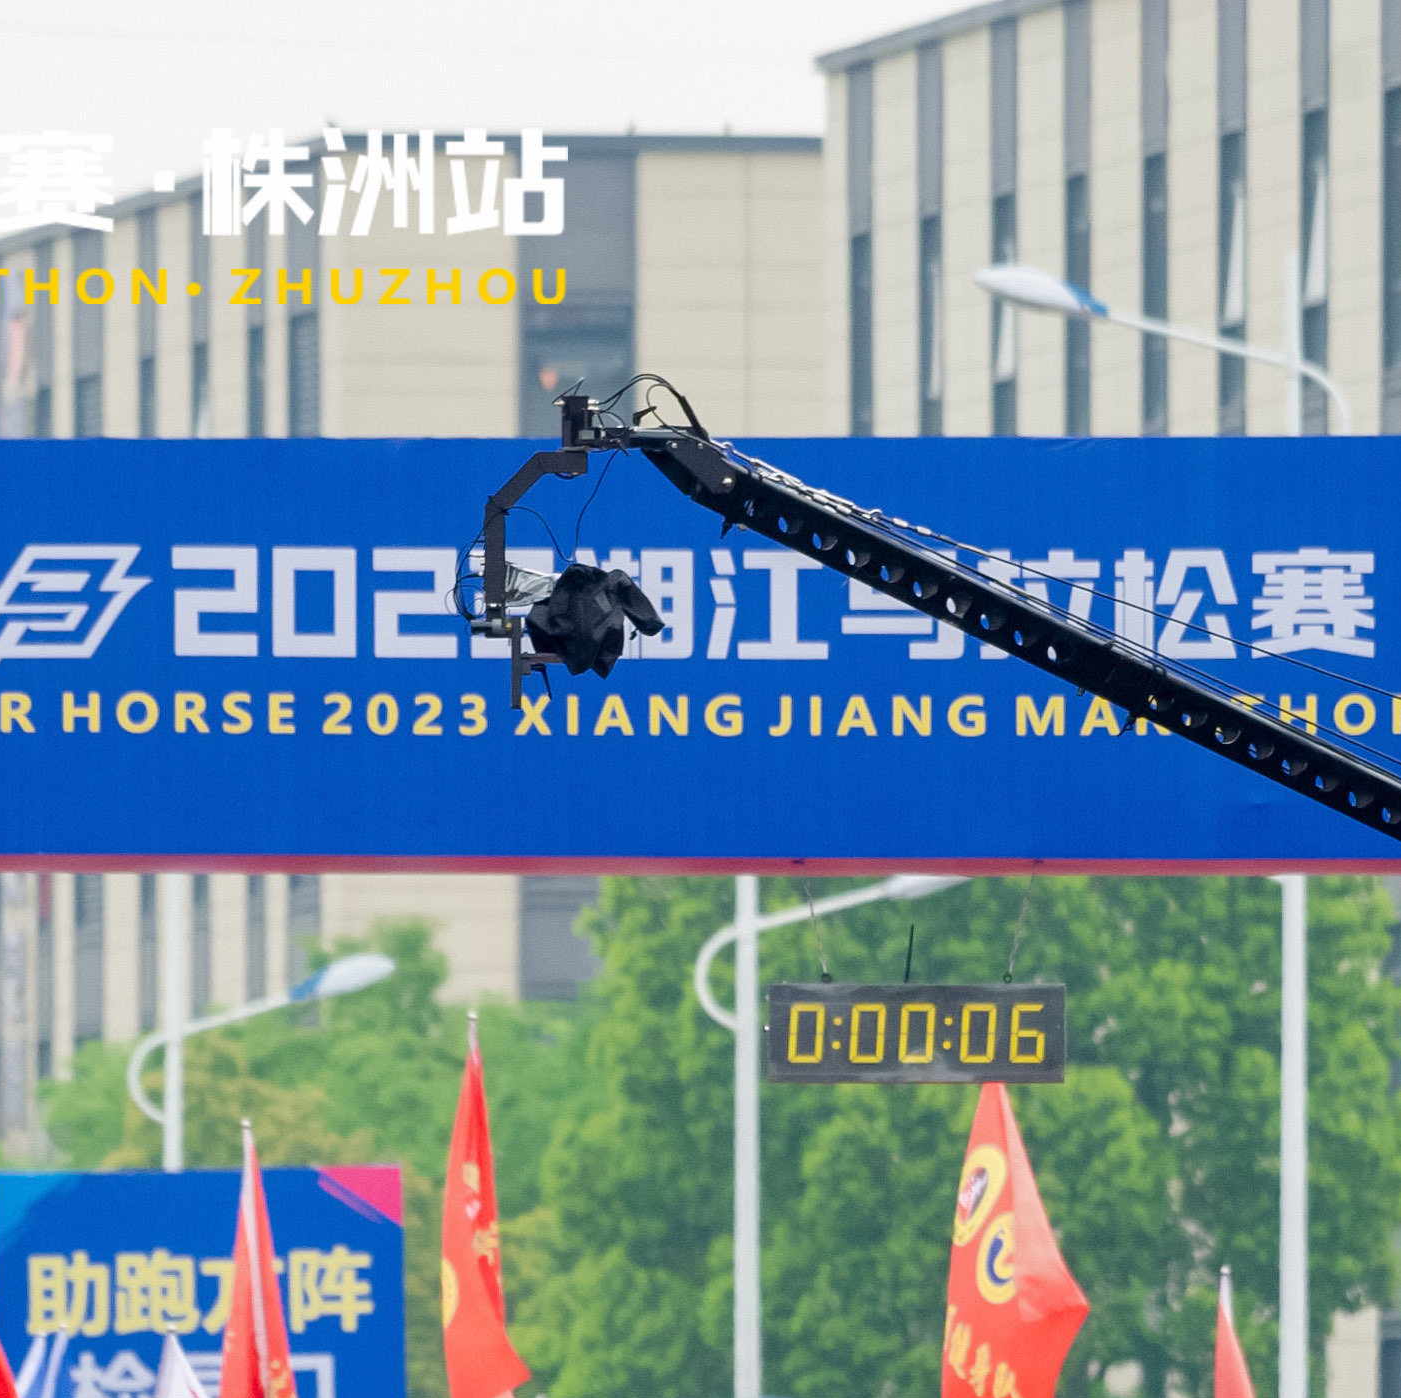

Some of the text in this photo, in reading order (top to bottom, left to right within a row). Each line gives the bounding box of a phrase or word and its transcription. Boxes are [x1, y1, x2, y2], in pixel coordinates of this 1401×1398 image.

[63, 692, 296, 734] HORSE
[322, 694, 489, 736] 2023
[515, 694, 744, 737] XIANG
[769, 694, 986, 737] JIANG
[787, 1001, 1046, 1065] 0:00:06
